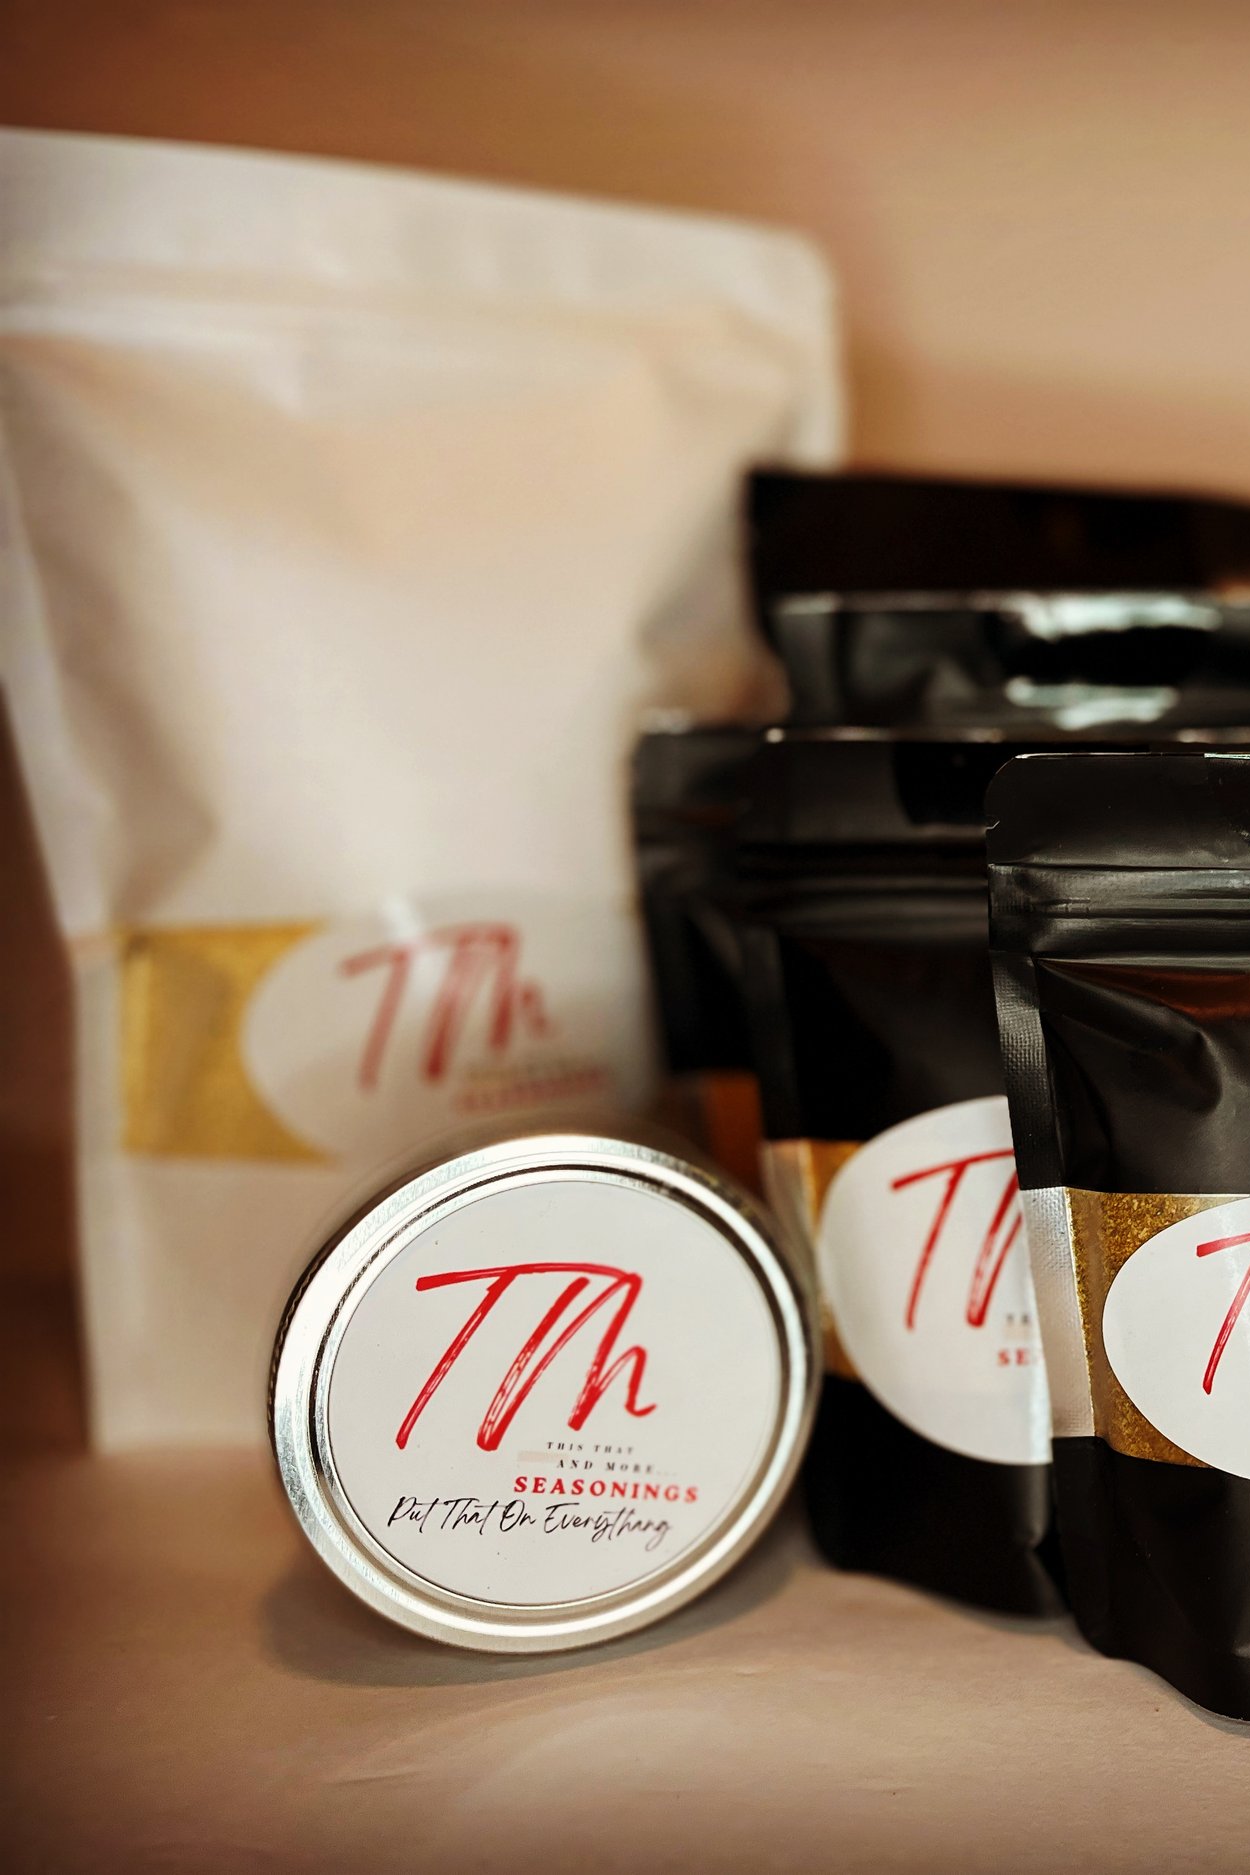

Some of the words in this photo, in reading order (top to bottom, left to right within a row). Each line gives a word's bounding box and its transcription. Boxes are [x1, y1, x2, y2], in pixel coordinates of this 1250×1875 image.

[547, 1441, 584, 1452] THIS
[594, 1444, 634, 1455] THAT
[557, 1459, 593, 1470] AND
[513, 1475, 699, 1504] SEASONINGS
[387, 1496, 445, 1533] Put
[441, 1498, 506, 1535] That
[499, 1499, 537, 1534] On
